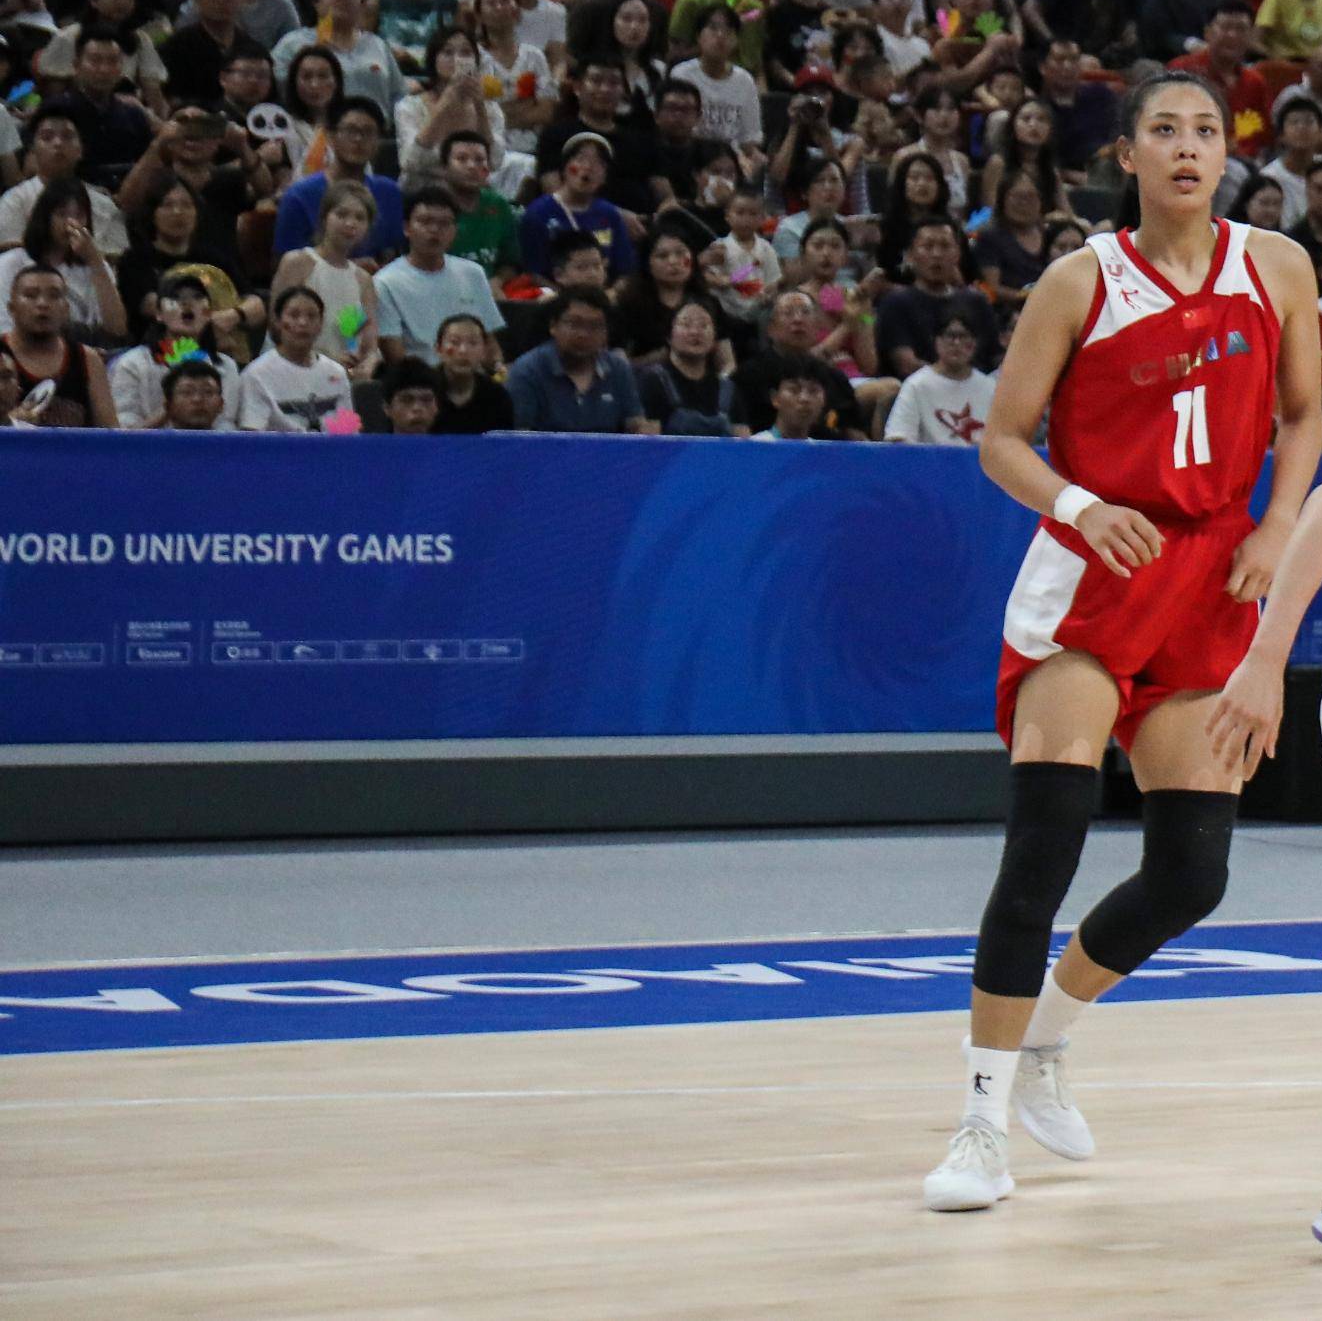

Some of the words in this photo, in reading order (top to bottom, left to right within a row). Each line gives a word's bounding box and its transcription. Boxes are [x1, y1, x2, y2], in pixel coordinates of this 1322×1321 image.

[1171, 384, 1212, 470] 11
[123, 531, 330, 565] UNIVERSITY
[336, 531, 454, 565] GAMES
